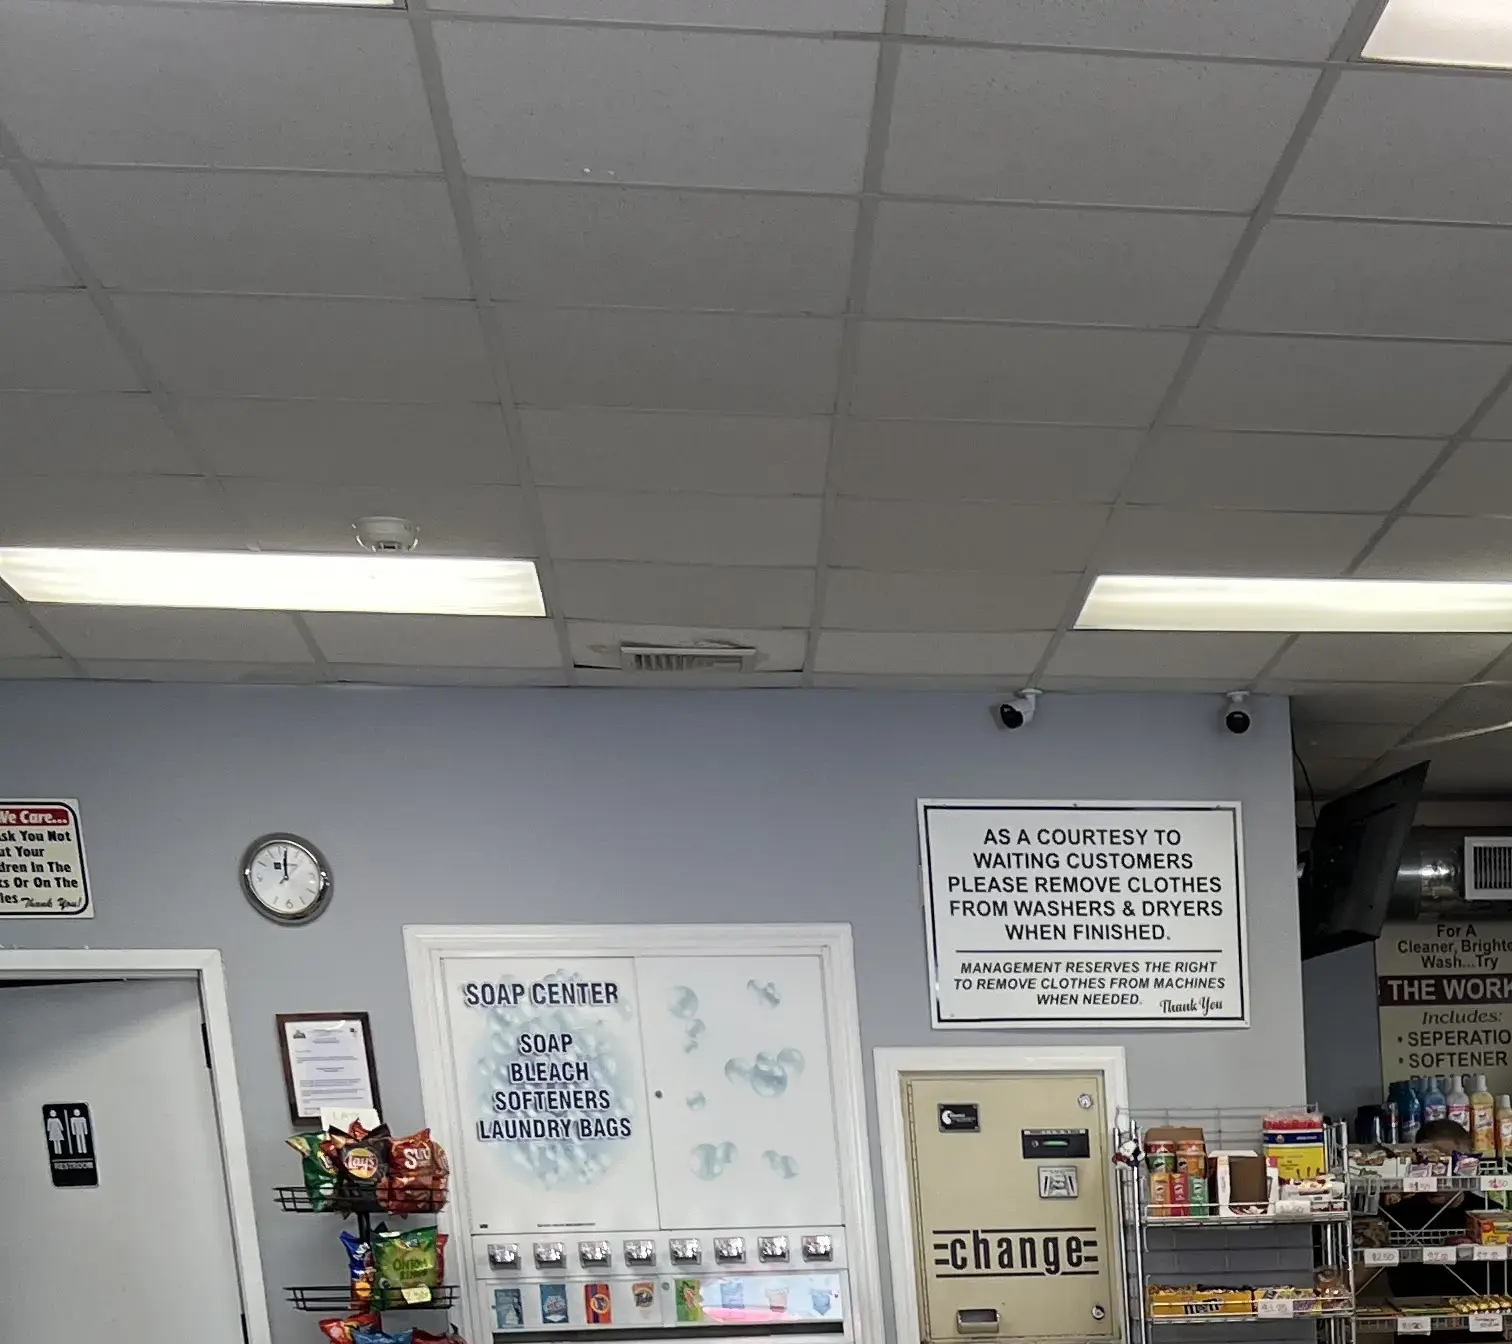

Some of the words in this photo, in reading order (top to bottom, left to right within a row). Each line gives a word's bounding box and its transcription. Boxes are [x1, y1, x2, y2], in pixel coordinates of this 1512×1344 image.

[20, 810, 67, 824] Care...
[20, 830, 44, 841] You
[47, 830, 72, 841] Not
[983, 828, 1011, 846] AS
[1016, 829, 1032, 846] A
[1036, 828, 1148, 846] COURTESY
[1154, 829, 1182, 846] TO
[0, 847, 11, 857] ut
[15, 846, 44, 857] Your
[31, 861, 44, 872] In
[47, 861, 71, 873] The
[973, 852, 1060, 870] WAITING
[1066, 852, 1194, 870] CUSTOMERS
[14, 877, 29, 888] Or
[33, 877, 51, 888] On
[54, 877, 78, 888] The
[948, 876, 1029, 893] PLEASE
[1035, 876, 1121, 893] REMOVE
[1127, 876, 1222, 893] CLOTHES
[950, 900, 1008, 917] FROM
[1014, 900, 1116, 917] WASHERS
[1122, 900, 1136, 917] &
[1142, 900, 1223, 917] DRYERS
[1005, 923, 1067, 941] WHEN
[1073, 924, 1171, 941] FINISHED.
[1437, 924, 1461, 938] For
[1465, 924, 1477, 938] A
[1397, 940, 1459, 954] Cleaner,
[960, 961, 1062, 974] MANAGEMENT
[1065, 961, 1140, 974] RESERVES
[1146, 961, 1172, 974] THE
[1175, 961, 1217, 974] RIGHT
[954, 978, 973, 991] TO
[976, 978, 1037, 991] REMOVE
[1041, 978, 1106, 990] CLOTHES
[1109, 977, 1150, 990] FROM
[1153, 977, 1226, 990] MACHINES
[1387, 979, 1436, 1001] THE
[466, 983, 525, 1005] SOAP
[531, 982, 618, 1005] CENTER
[1036, 993, 1078, 1006] WHEN
[1082, 993, 1143, 1005] NEEDED.
[1159, 999, 1197, 1014] Thank
[1199, 996, 1223, 1016] You
[1422, 1009, 1502, 1025] Includes:
[520, 1034, 573, 1053] SOAP
[1408, 1051, 1508, 1069] SOFTENER
[510, 1062, 589, 1082] BLEACH
[494, 1090, 610, 1110] SOFTENERS
[479, 1119, 572, 1139] LAUNDRY
[581, 1117, 631, 1137] BAGS
[346, 1154, 375, 1171] Lay's
[949, 1229, 1082, 1275] change
